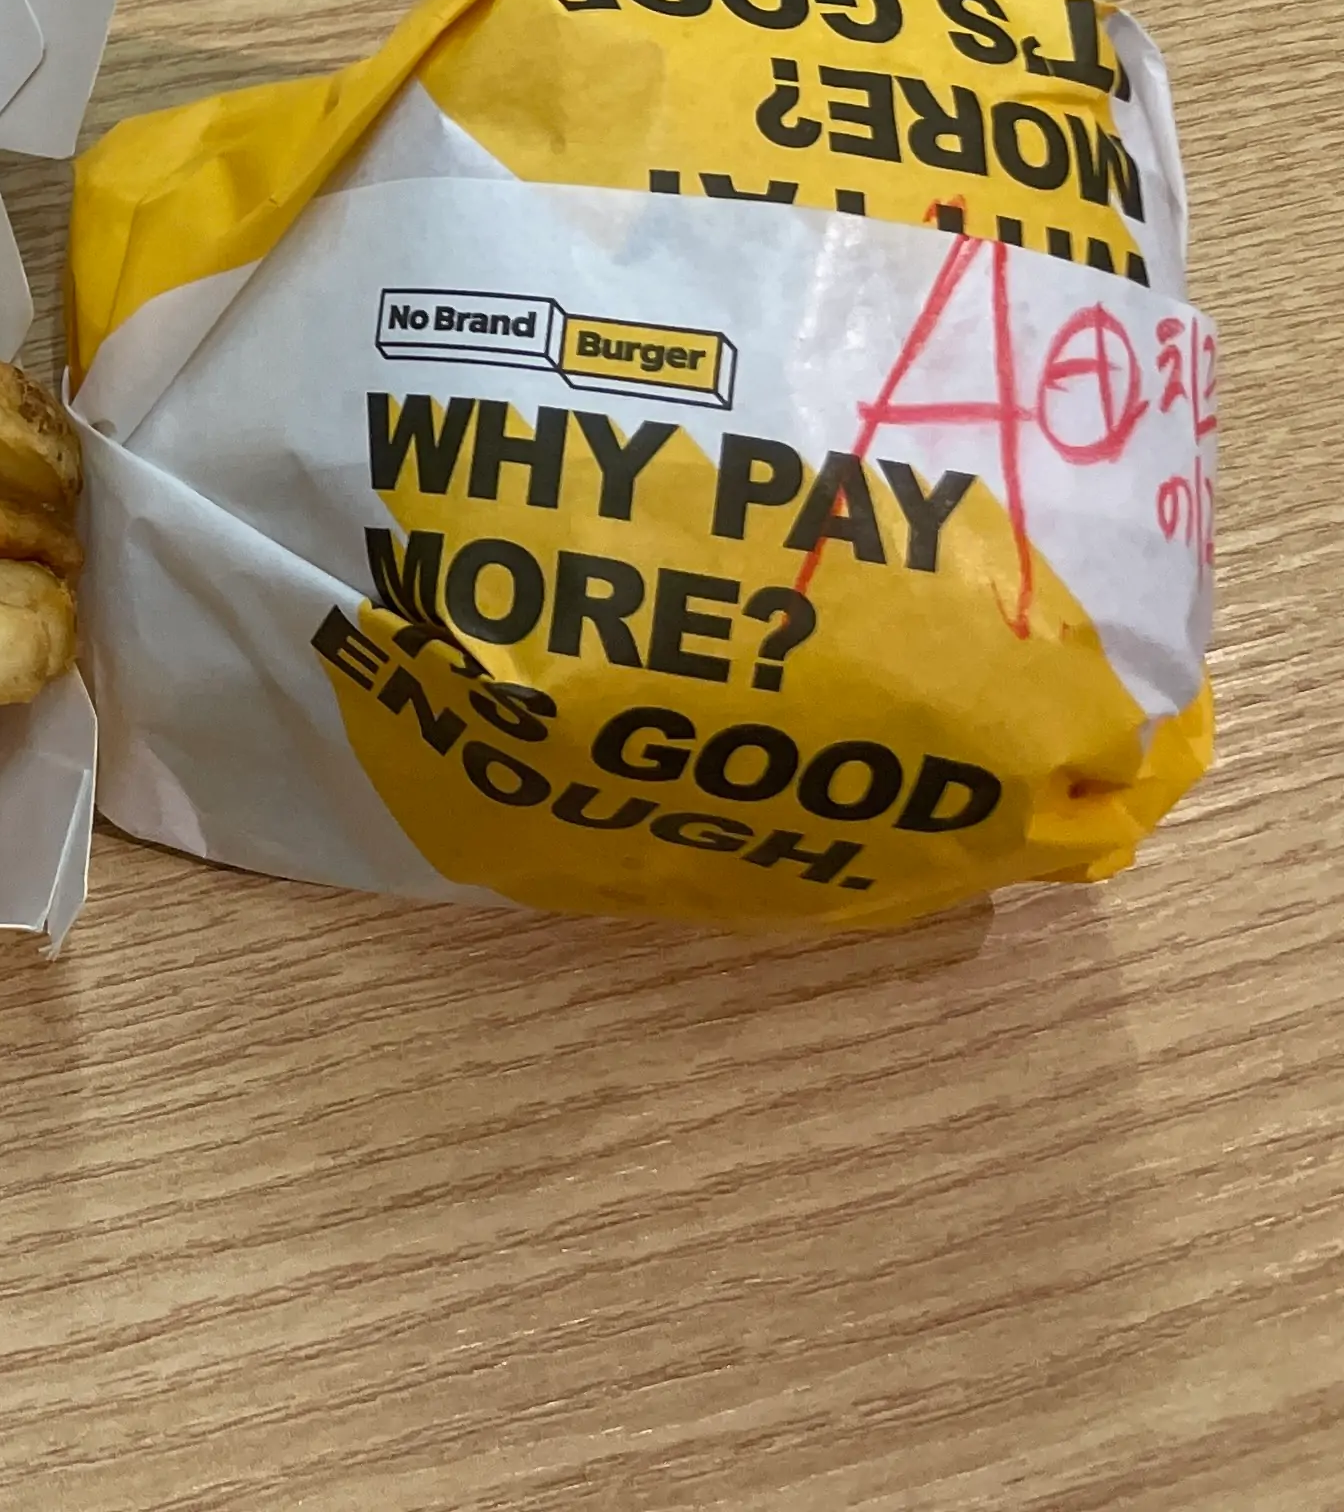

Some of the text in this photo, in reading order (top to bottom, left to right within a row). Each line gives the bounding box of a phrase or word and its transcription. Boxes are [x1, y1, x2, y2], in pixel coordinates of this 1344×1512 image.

[755, 57, 1145, 223] MORE?
[388, 305, 706, 371] No Brand Burger
[367, 391, 978, 573] WHY PAY
[364, 526, 817, 692] MORE?
[310, 604, 878, 891] ENOUGH.
[591, 706, 1002, 834] GOOD
